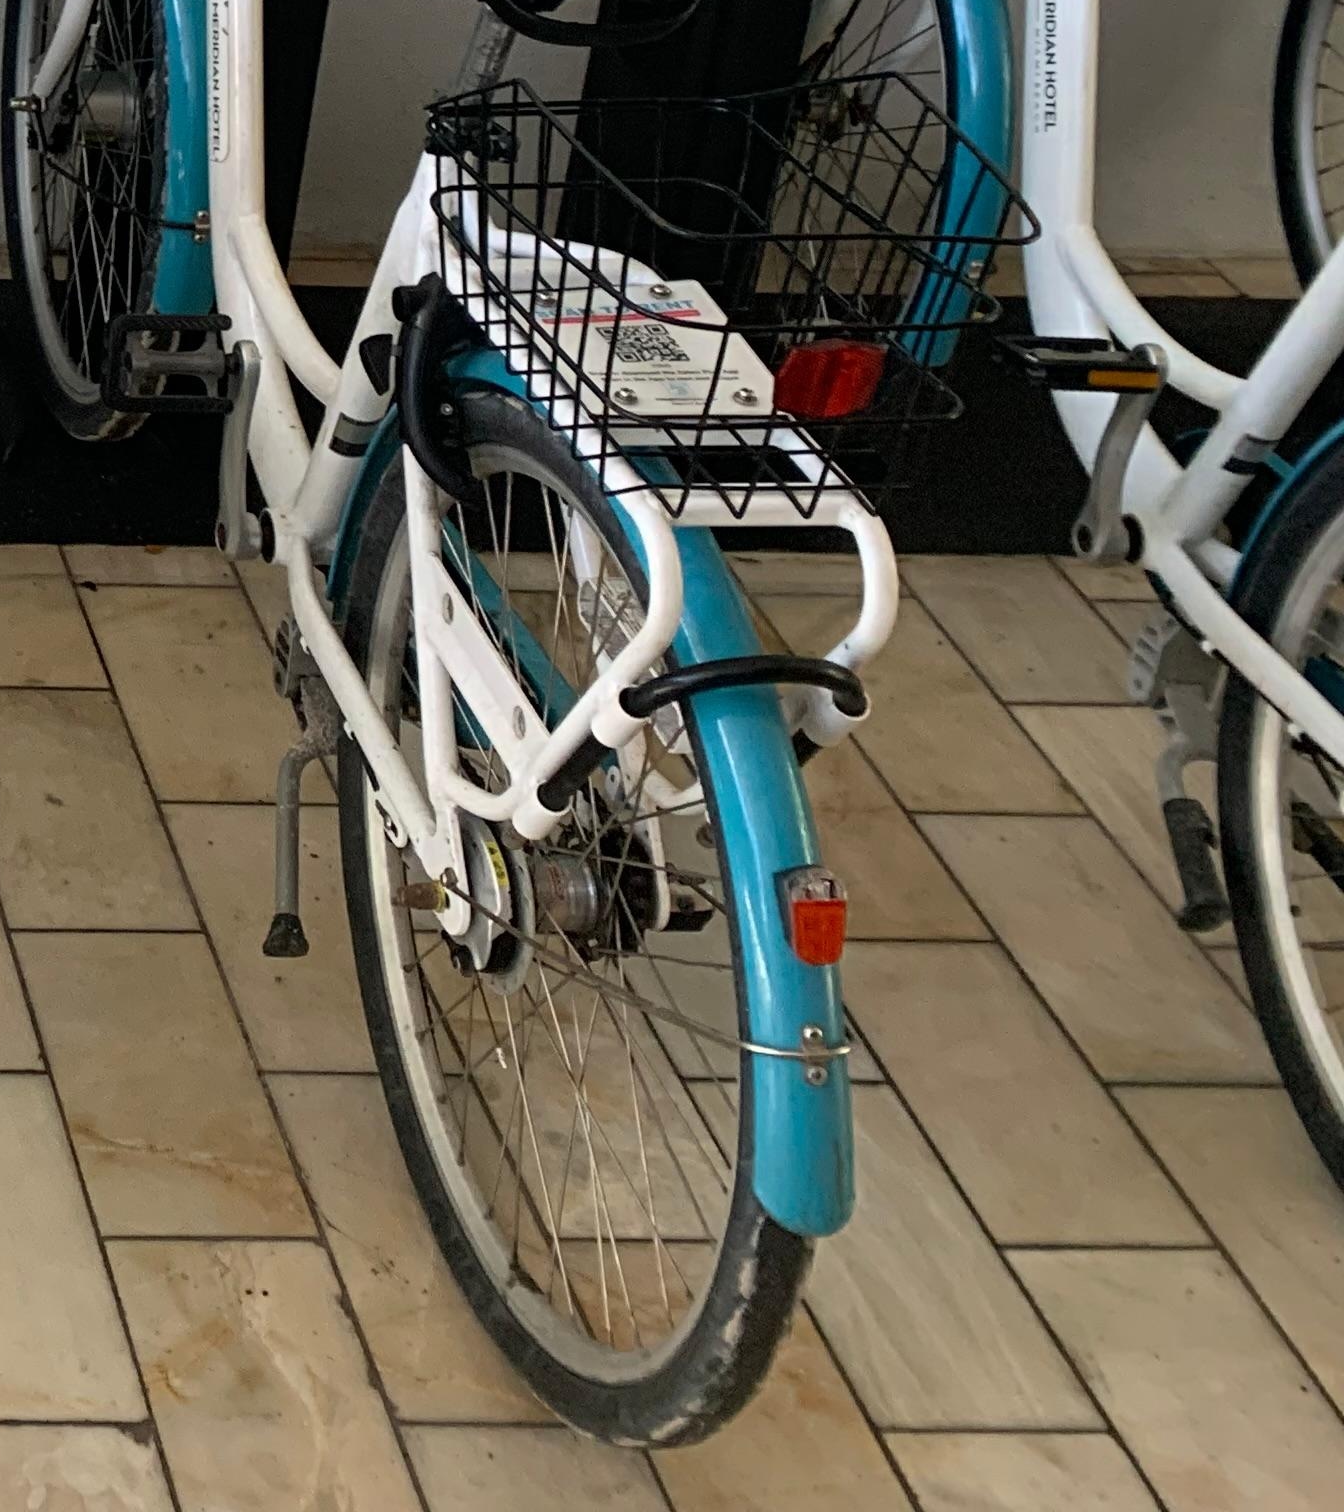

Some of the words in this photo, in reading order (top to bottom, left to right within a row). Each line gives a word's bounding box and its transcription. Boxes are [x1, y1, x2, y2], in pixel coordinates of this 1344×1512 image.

[212, 2, 221, 91] MERIDIAN
[213, 96, 221, 155] HOTEL
[1044, 72, 1056, 133] HOTEL
